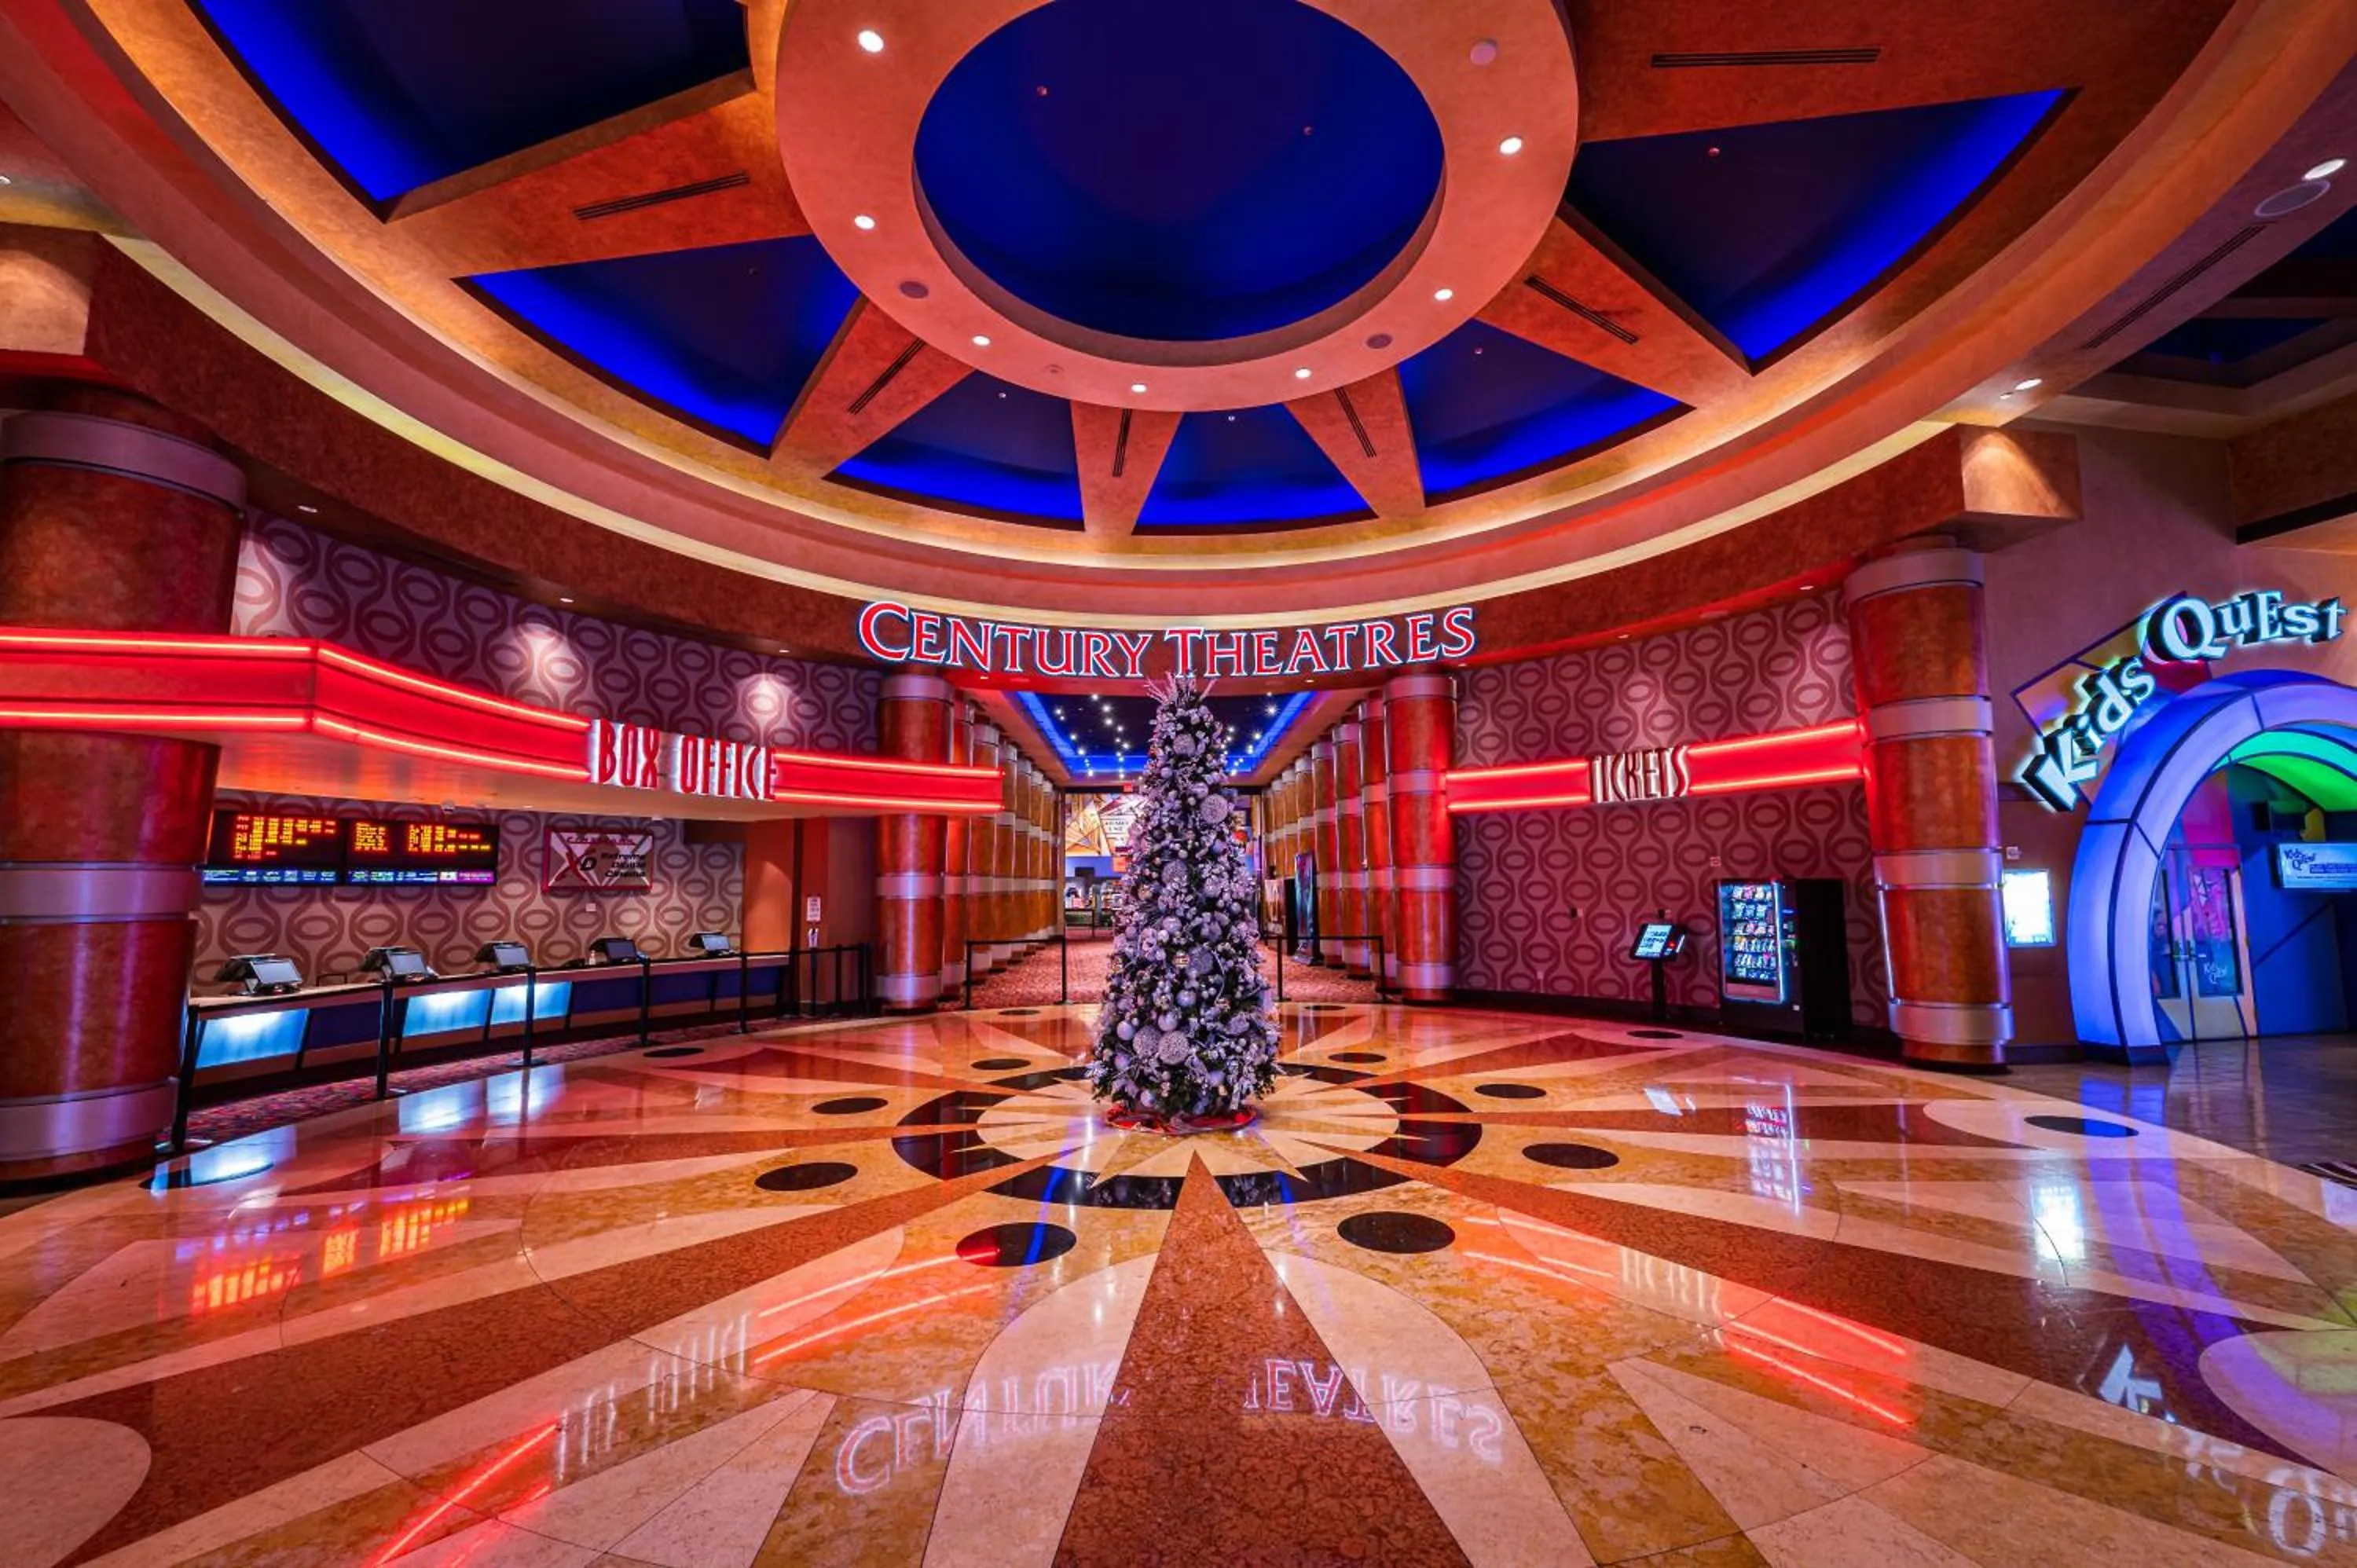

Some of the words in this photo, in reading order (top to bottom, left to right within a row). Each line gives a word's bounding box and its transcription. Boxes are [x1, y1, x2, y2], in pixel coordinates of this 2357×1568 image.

[859, 601, 1152, 678] CENTURY
[1164, 607, 1475, 678] THEATRES
[593, 717, 661, 790] BOX
[676, 734, 777, 801] OFFICE
[1586, 745, 1689, 803] TICKETS
[2016, 654, 2157, 814] Kids
